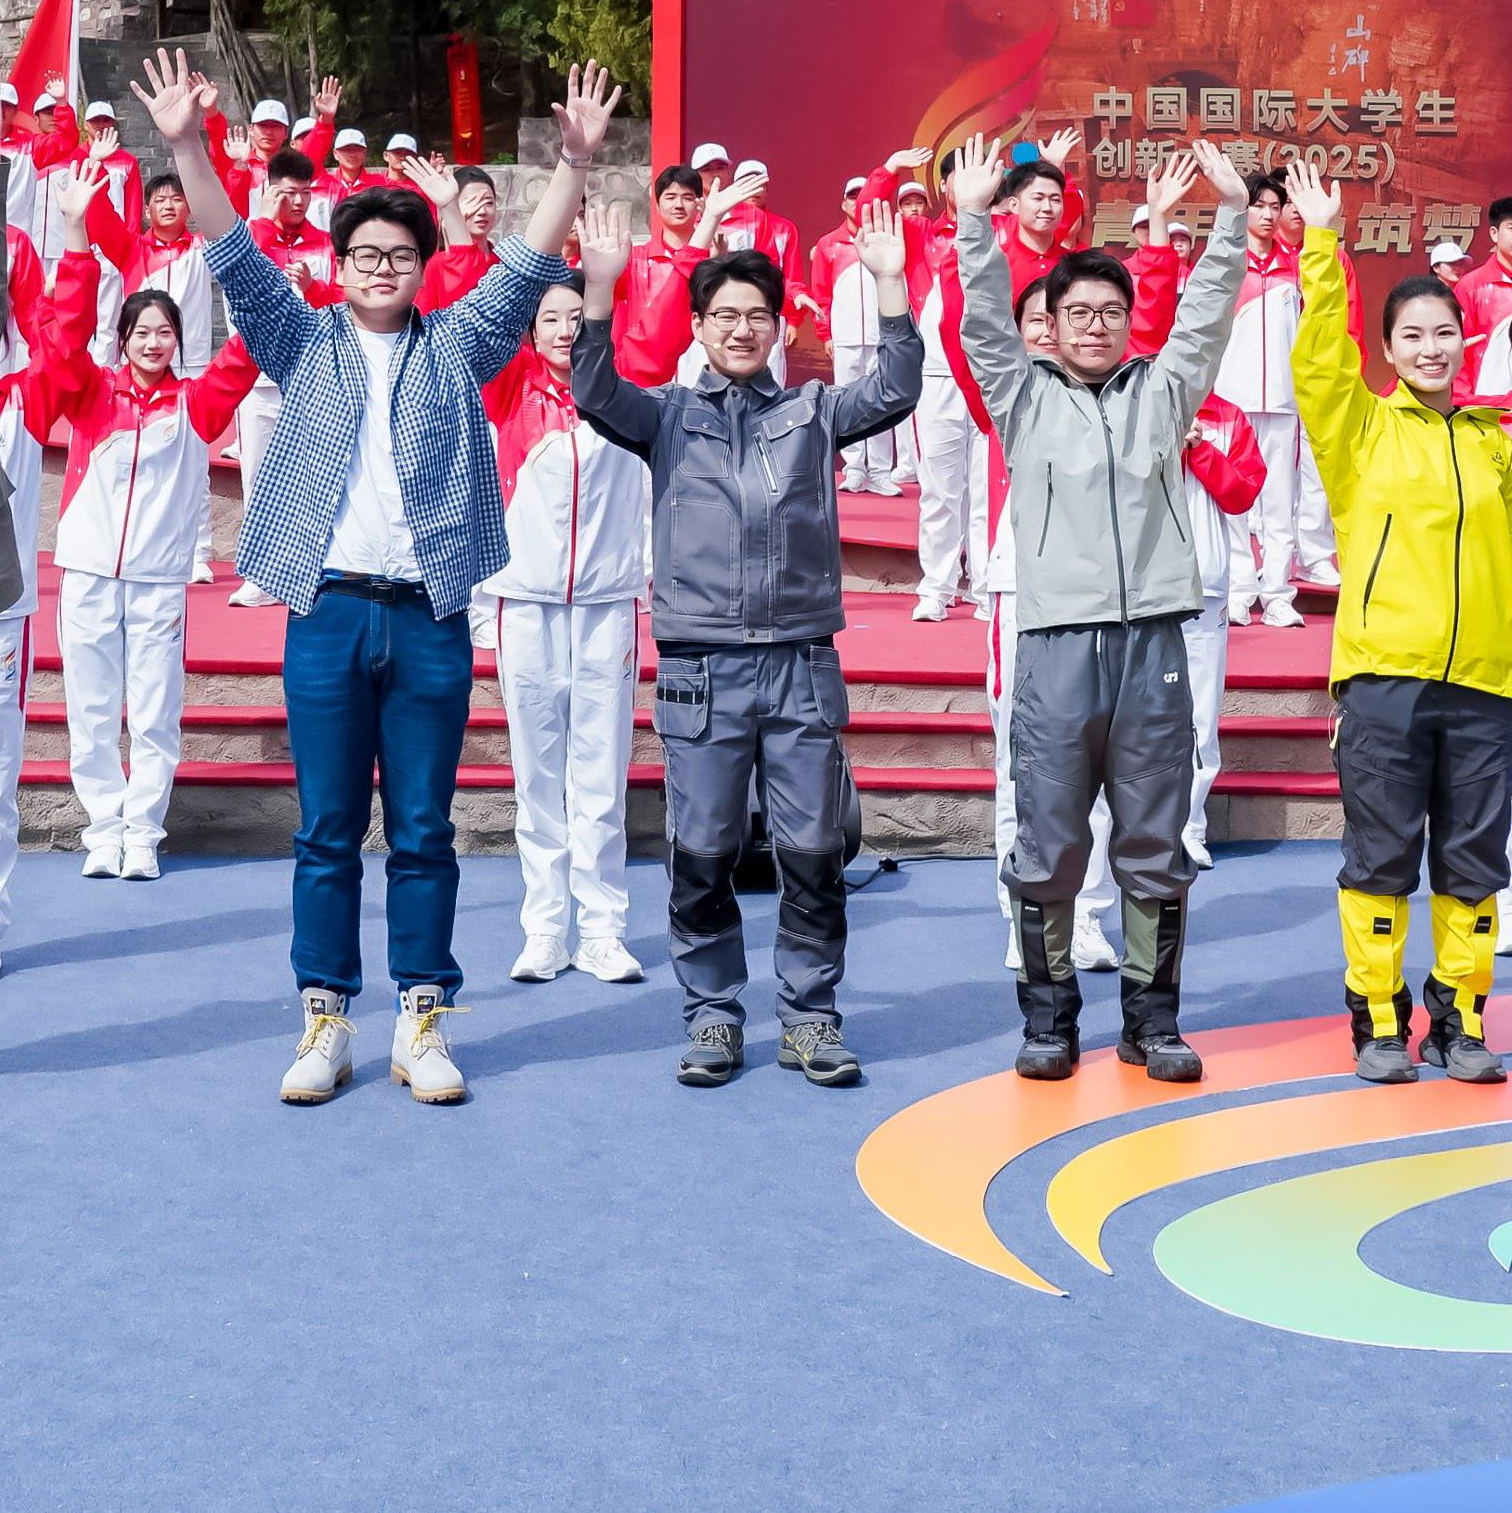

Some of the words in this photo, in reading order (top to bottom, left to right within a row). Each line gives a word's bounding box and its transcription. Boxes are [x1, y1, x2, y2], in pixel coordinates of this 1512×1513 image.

[1092, 85, 1459, 134] 中国国际大学生
[1092, 137, 1396, 184] 创新赛(2025)
